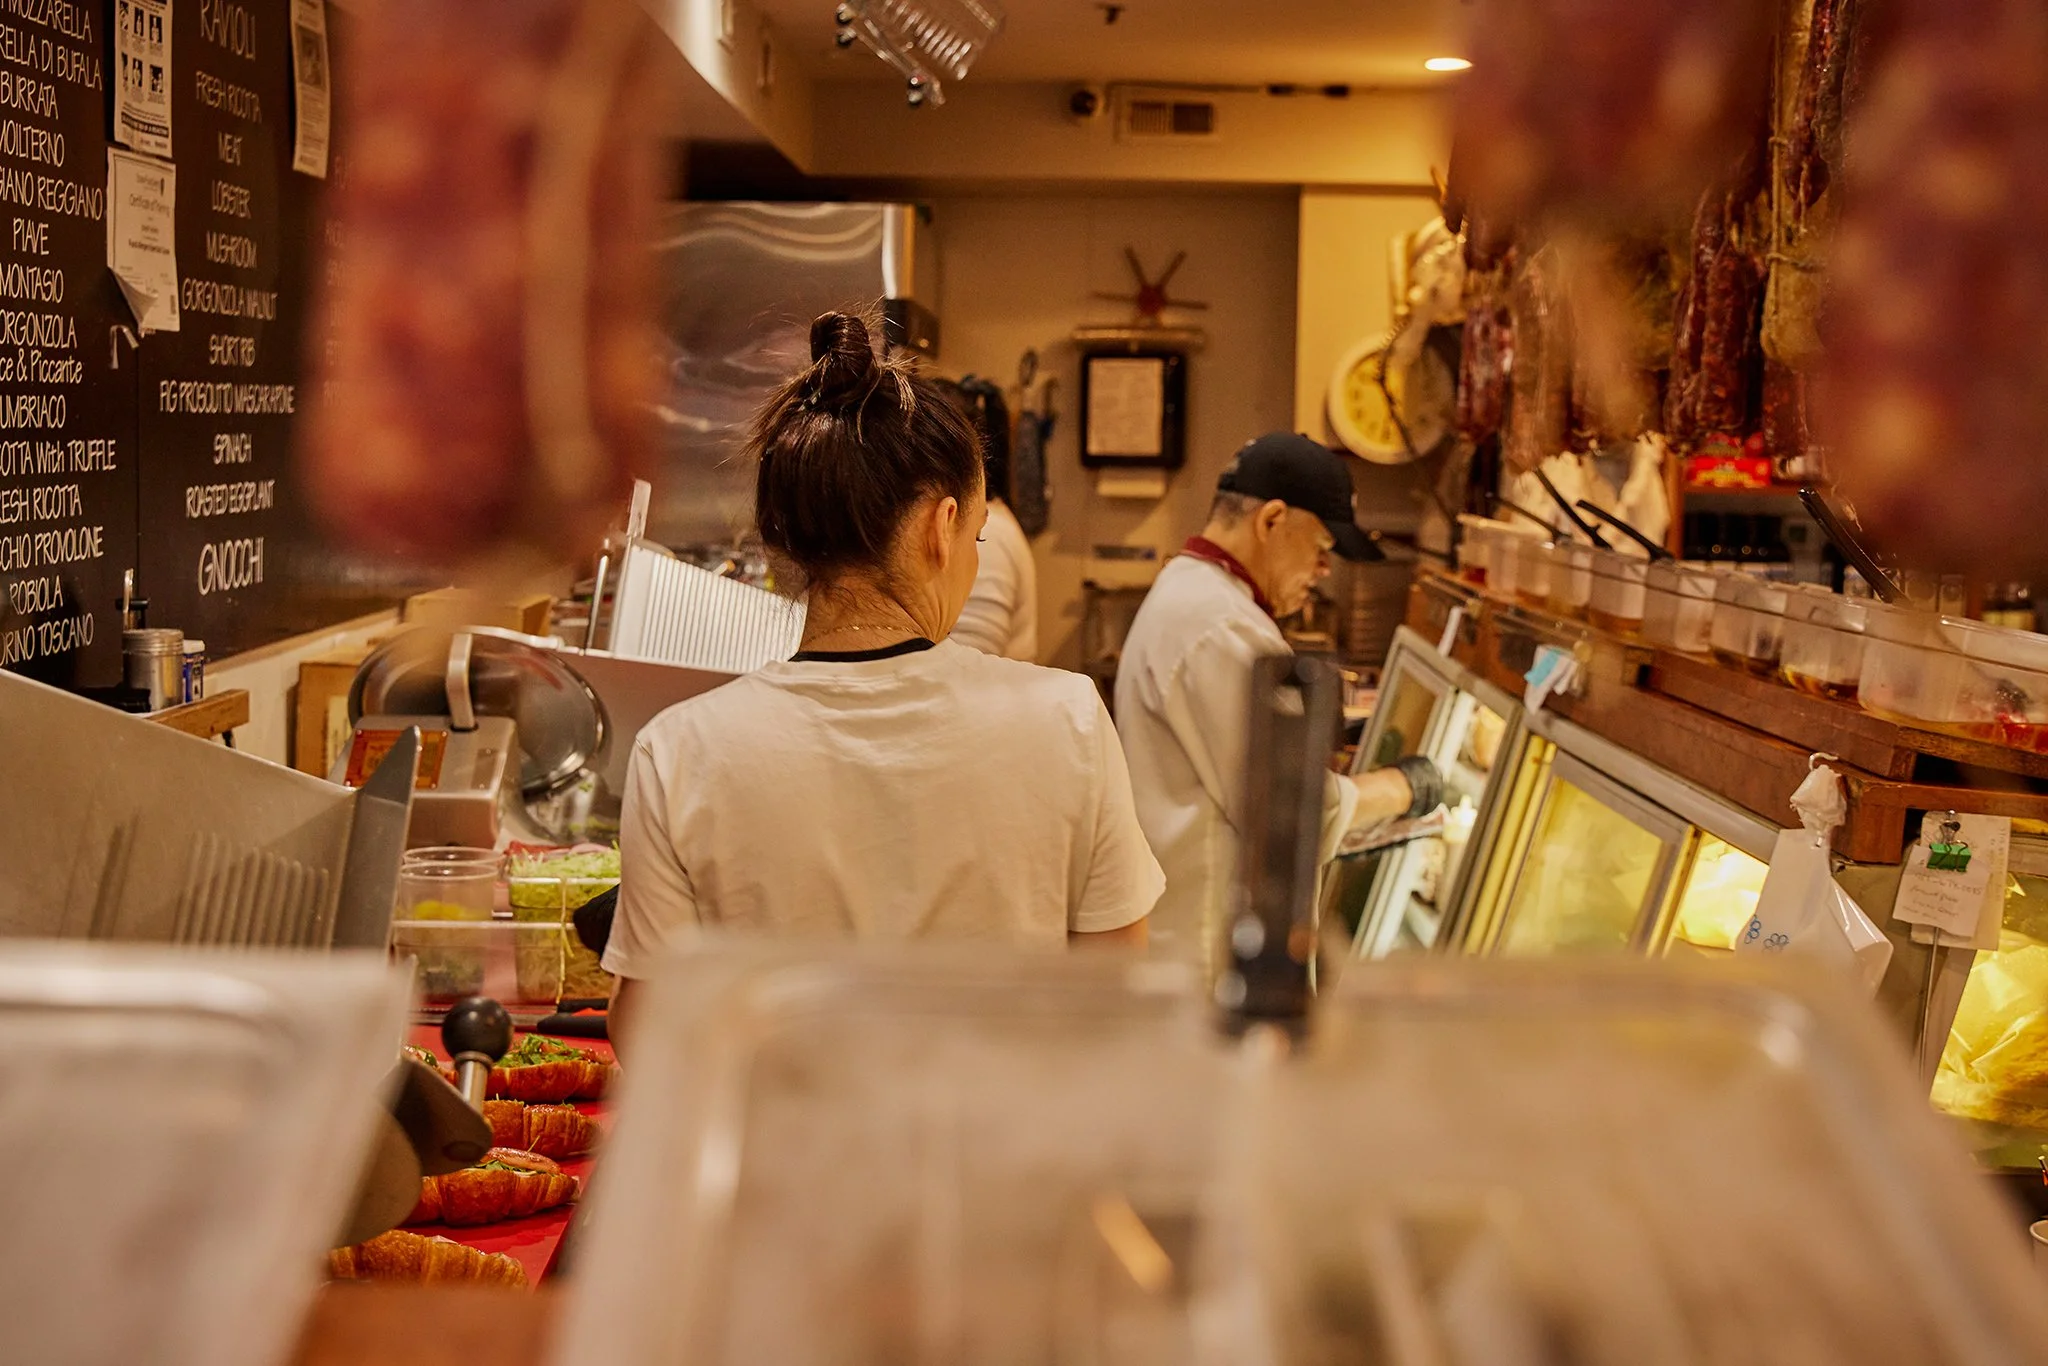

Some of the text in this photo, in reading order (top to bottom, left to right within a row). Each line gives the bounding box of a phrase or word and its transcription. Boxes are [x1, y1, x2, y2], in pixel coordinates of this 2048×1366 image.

[201, 0, 257, 61] RAVIOLI
[42, 39, 53, 74] DI
[57, 46, 102, 91] BUFALA
[1, 71, 59, 120] BURRATA
[196, 71, 227, 112] FRESH
[38, 176, 103, 220] REGGIANO
[212, 180, 251, 219] LOBSTER
[13, 218, 49, 255] PIAVE
[206, 230, 257, 268] MUSHROOM
[0, 262, 64, 303] MONTASIO
[182, 277, 245, 318] GORGONZOLA
[17, 348, 28, 381] &
[31, 349, 82, 384] Piccante
[209, 334, 240, 366] SHORT
[160, 380, 178, 413] FIG
[0, 440, 34, 476] OTTA
[67, 439, 117, 472] TRUFFLE
[213, 433, 252, 465] SPINACH
[0, 484, 82, 523] ESH RICOTTA
[186, 479, 275, 518] ROASTED EGGPLANT
[0, 526, 104, 571] CHIO PROVOLONE
[198, 536, 264, 596] GNOCCHI
[9, 575, 63, 615] ROBIOLA
[38, 612, 94, 656] TOSCANO
